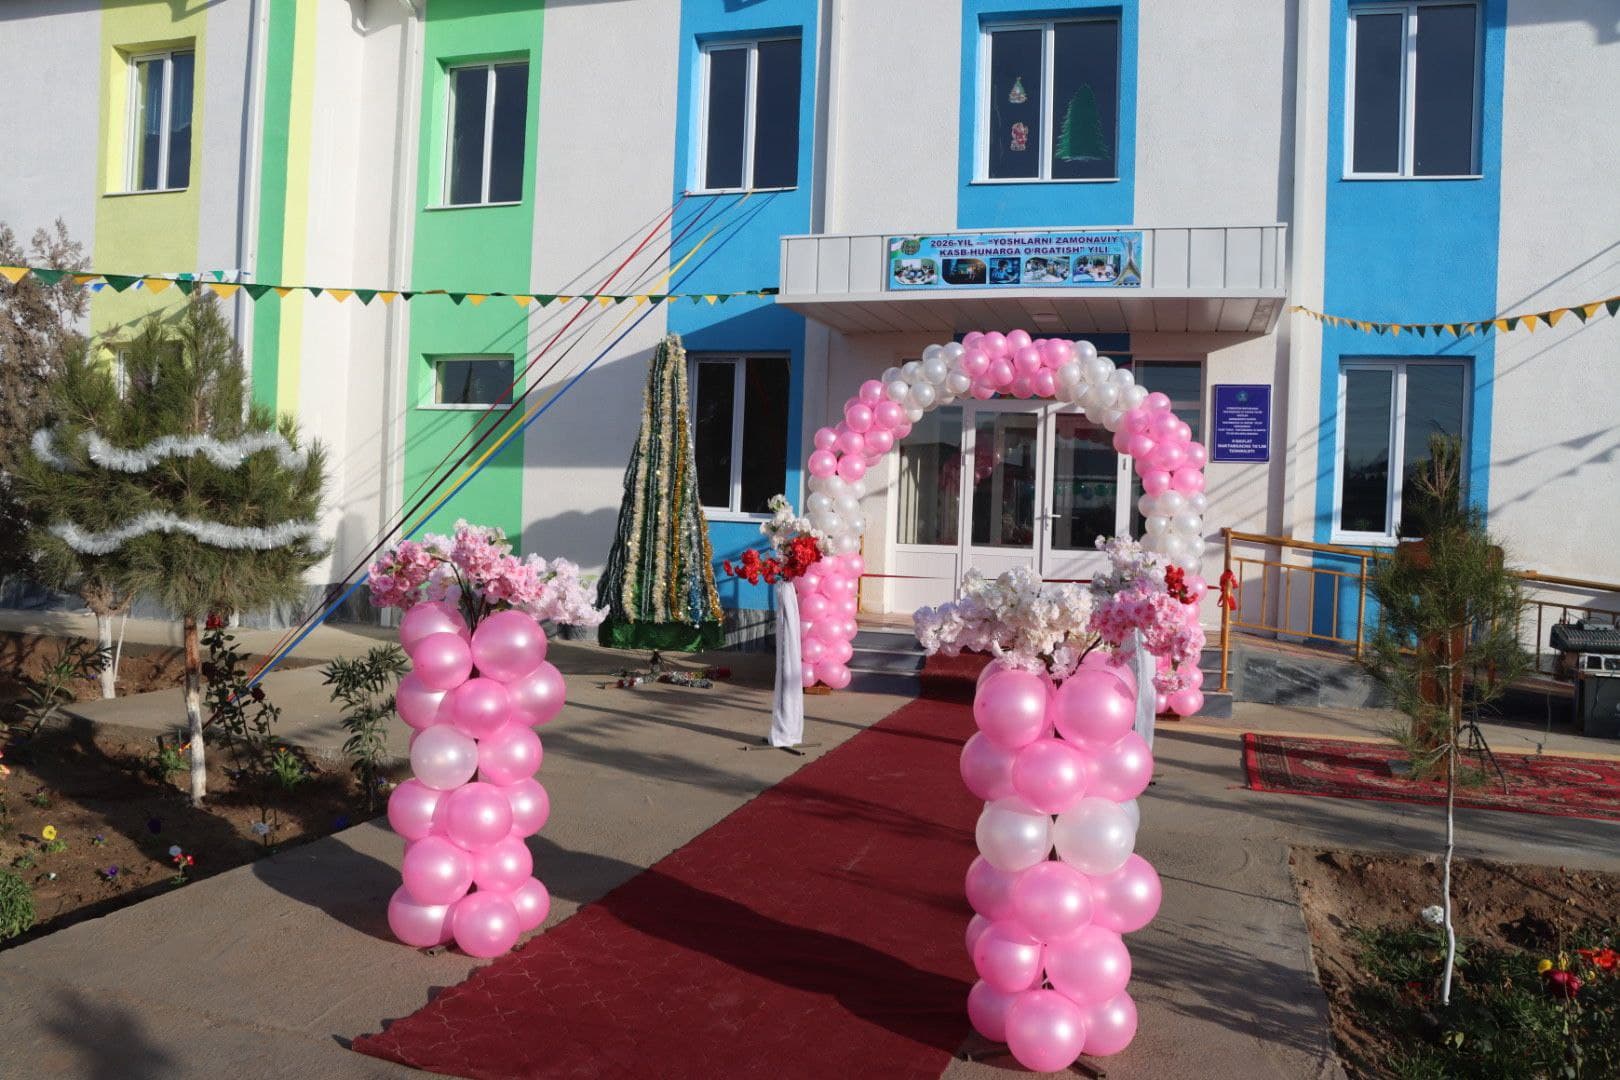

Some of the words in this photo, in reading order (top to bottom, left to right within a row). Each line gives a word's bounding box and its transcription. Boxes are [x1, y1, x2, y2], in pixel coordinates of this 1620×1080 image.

[931, 239, 973, 247] 2026-YIL
[988, 238, 1052, 246] "YOSHLARNI
[1055, 236, 1117, 244] ZAMONAVIY
[939, 248, 1021, 256] KASB-HUNARGA
